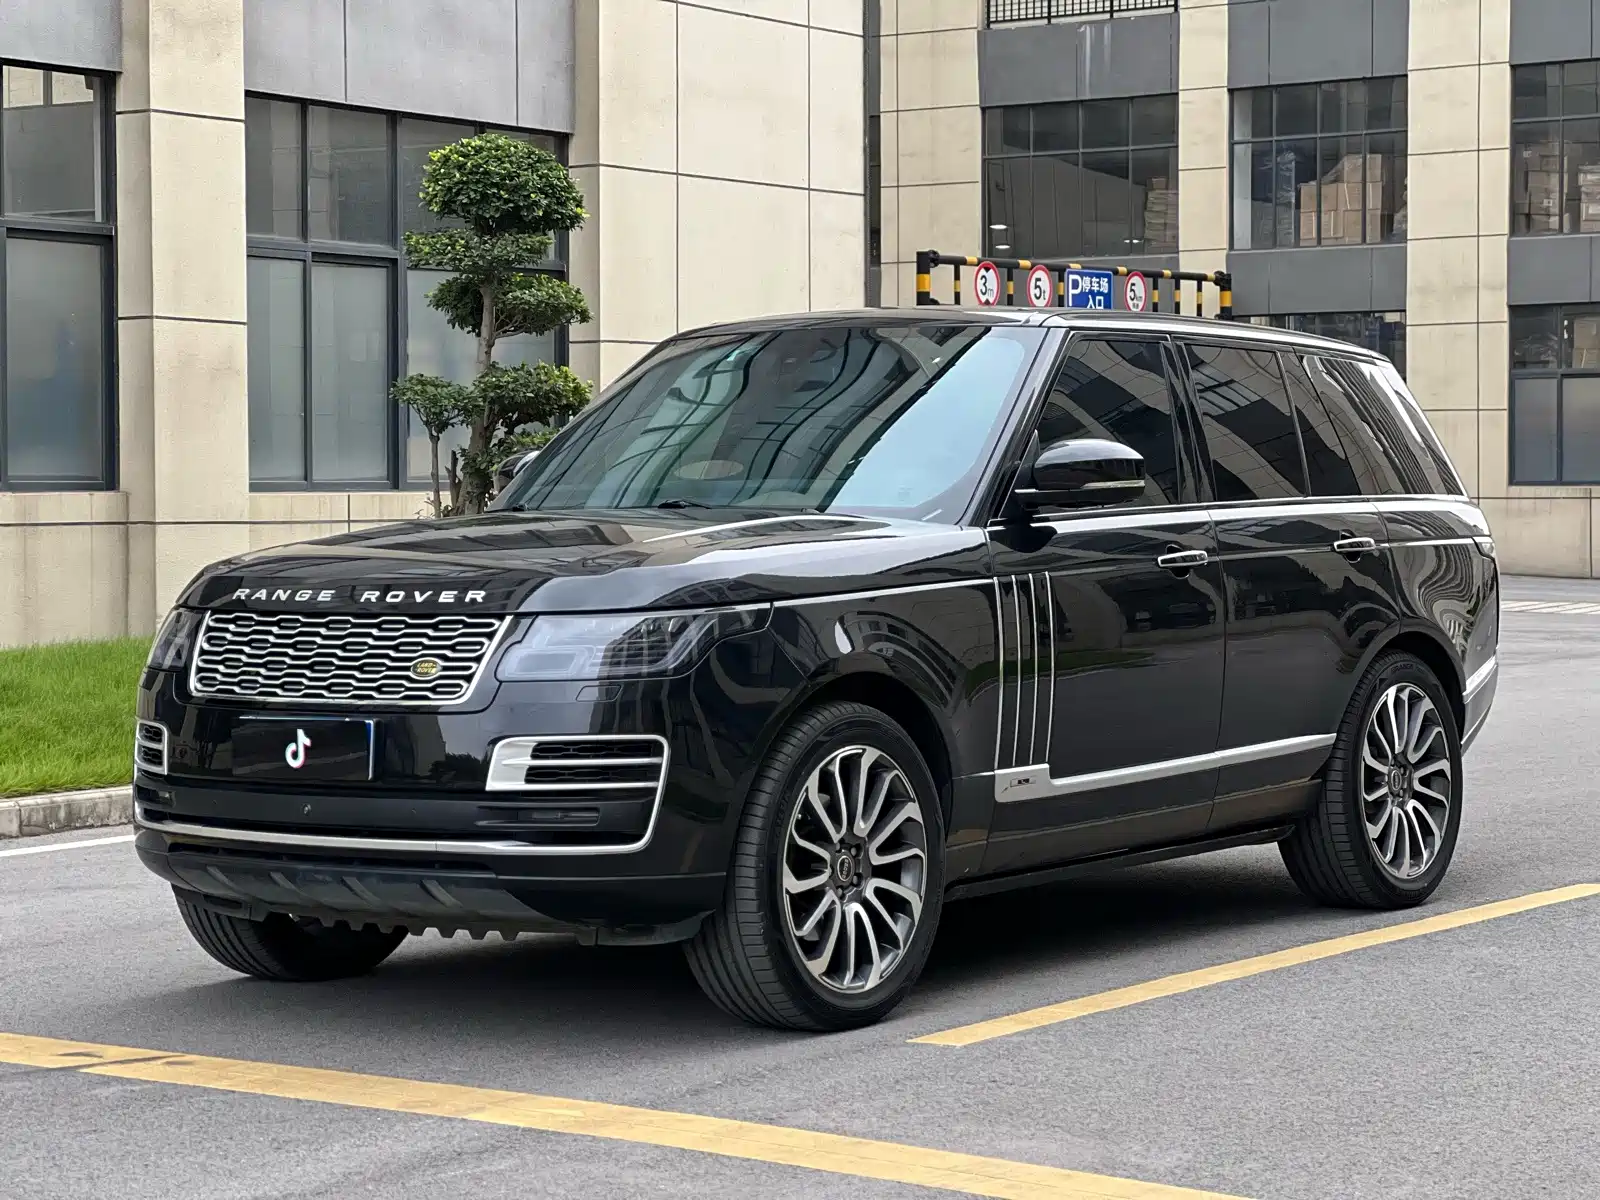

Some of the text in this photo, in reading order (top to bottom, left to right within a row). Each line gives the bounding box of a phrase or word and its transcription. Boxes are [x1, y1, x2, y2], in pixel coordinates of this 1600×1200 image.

[980, 275, 994, 297] 3m
[1068, 274, 1082, 307] P
[1082, 276, 1109, 293] 停车场
[1087, 295, 1104, 310] 入口
[231, 588, 486, 603] RANGE ROVER
